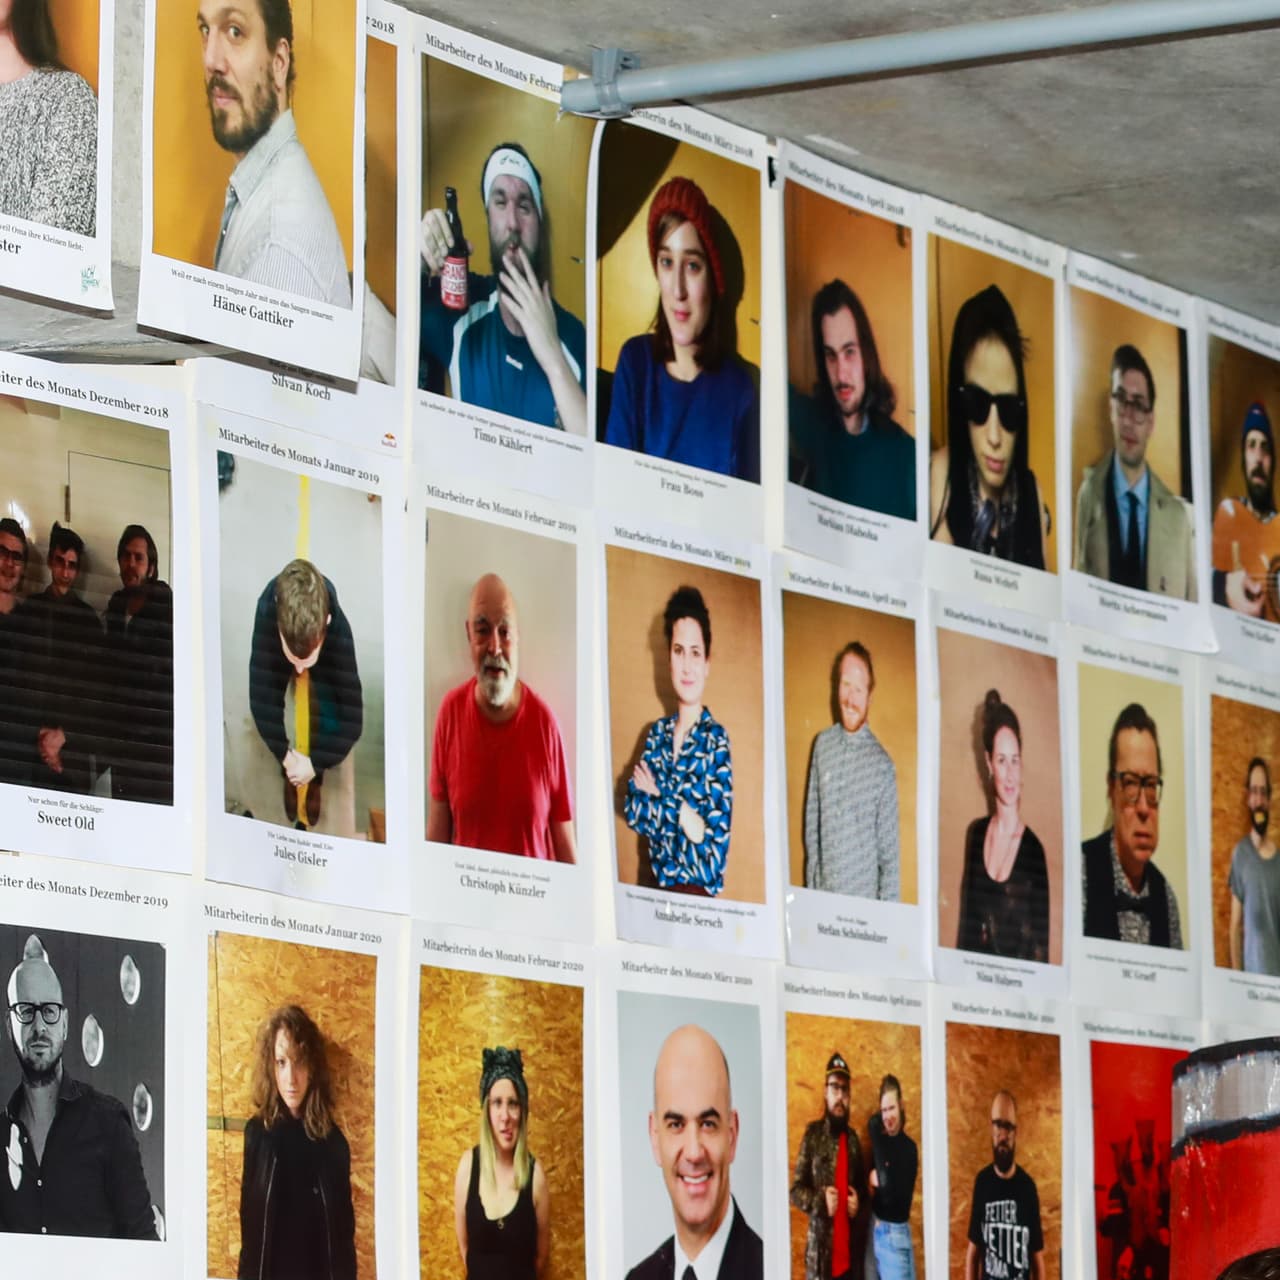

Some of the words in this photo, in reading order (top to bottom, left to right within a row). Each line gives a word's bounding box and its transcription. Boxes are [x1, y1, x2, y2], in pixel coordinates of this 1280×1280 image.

[370, 17, 395, 35] 2018
[425, 32, 477, 63] Mitarbeiter
[476, 53, 494, 70] des
[494, 59, 528, 83] Monats
[528, 72, 564, 94] Februa
[212, 293, 248, 316] Hänse
[248, 304, 295, 329] Gattiker
[0, 370, 24, 386] iter
[25, 375, 46, 390] des
[47, 379, 88, 400] Monats
[88, 389, 142, 413] Dezember
[143, 405, 169, 419] 2018
[270, 371, 303, 394] Silvan
[304, 379, 332, 401] Koch
[218, 426, 271, 453] Mitarbeiter
[270, 442, 287, 458] des
[287, 447, 323, 468] Monats
[323, 458, 357, 477] Januar
[357, 469, 380, 485] 2019
[472, 426, 498, 445] Timo
[498, 434, 533, 455] Kählert
[426, 484, 476, 507] Mitarbeiter
[475, 496, 491, 511] des
[491, 501, 523, 519] Monats
[523, 509, 558, 528] Februar
[37, 811, 73, 828] Sweet
[74, 815, 95, 831] Old
[273, 844, 297, 862] Jules
[297, 850, 328, 868] Gisler
[25, 876, 46, 891] des
[47, 879, 88, 897] Monats
[89, 885, 142, 904] Dezember
[143, 895, 169, 909] 2019
[459, 874, 507, 895] Christoph
[508, 882, 547, 899] Künzler
[203, 904, 270, 926] Mitarbeiterin
[270, 914, 287, 929] des
[287, 918, 324, 935] Monats
[324, 924, 359, 941] Januar
[359, 932, 383, 944] 2020
[693, 914, 724, 929] Sersch
[422, 937, 478, 958] Mitarbeiterin
[478, 946, 494, 959] des
[494, 948, 527, 964] Monats
[527, 953, 562, 969] Februar
[561, 960, 585, 972] 2020
[621, 960, 669, 976] Mitarbeiter
[669, 965, 684, 978] des
[684, 967, 714, 981] Monats
[713, 970, 734, 984] März
